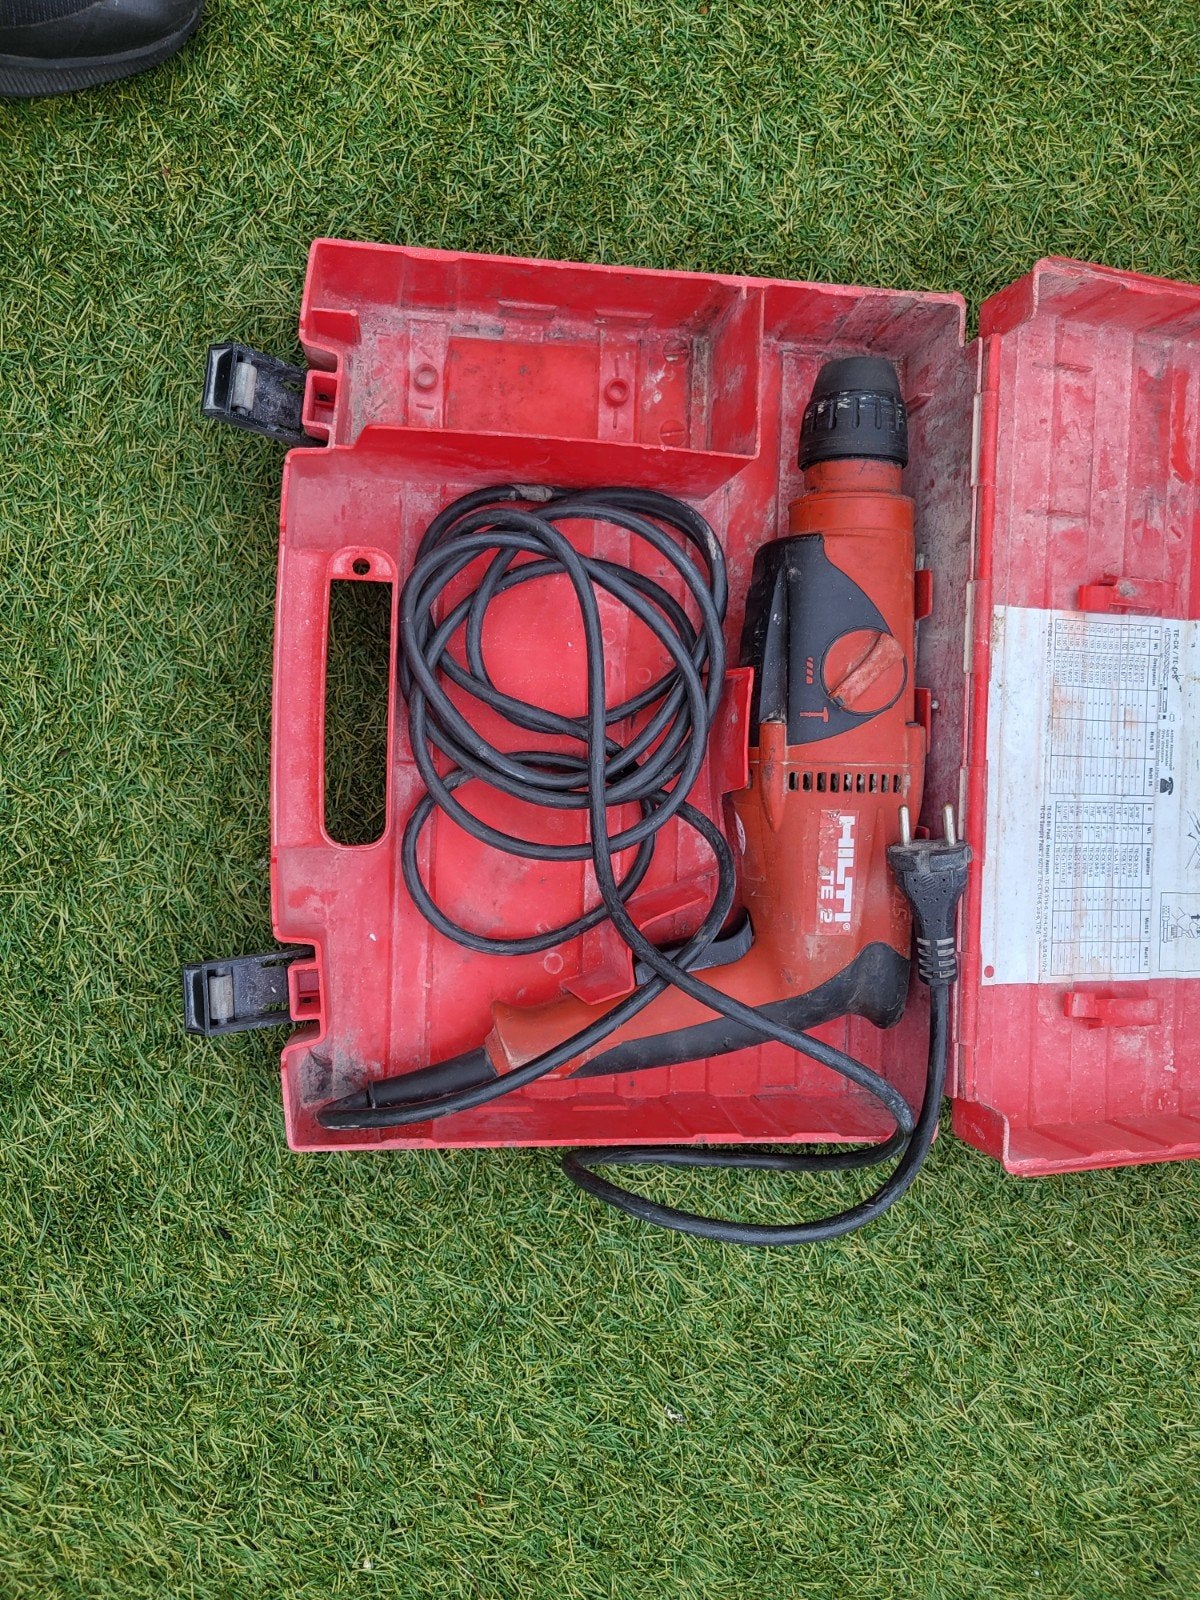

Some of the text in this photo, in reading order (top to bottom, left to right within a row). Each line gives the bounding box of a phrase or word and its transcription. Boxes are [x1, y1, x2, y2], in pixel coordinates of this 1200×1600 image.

[820, 870, 834, 923] TE 2
[835, 815, 855, 922] HILTI
